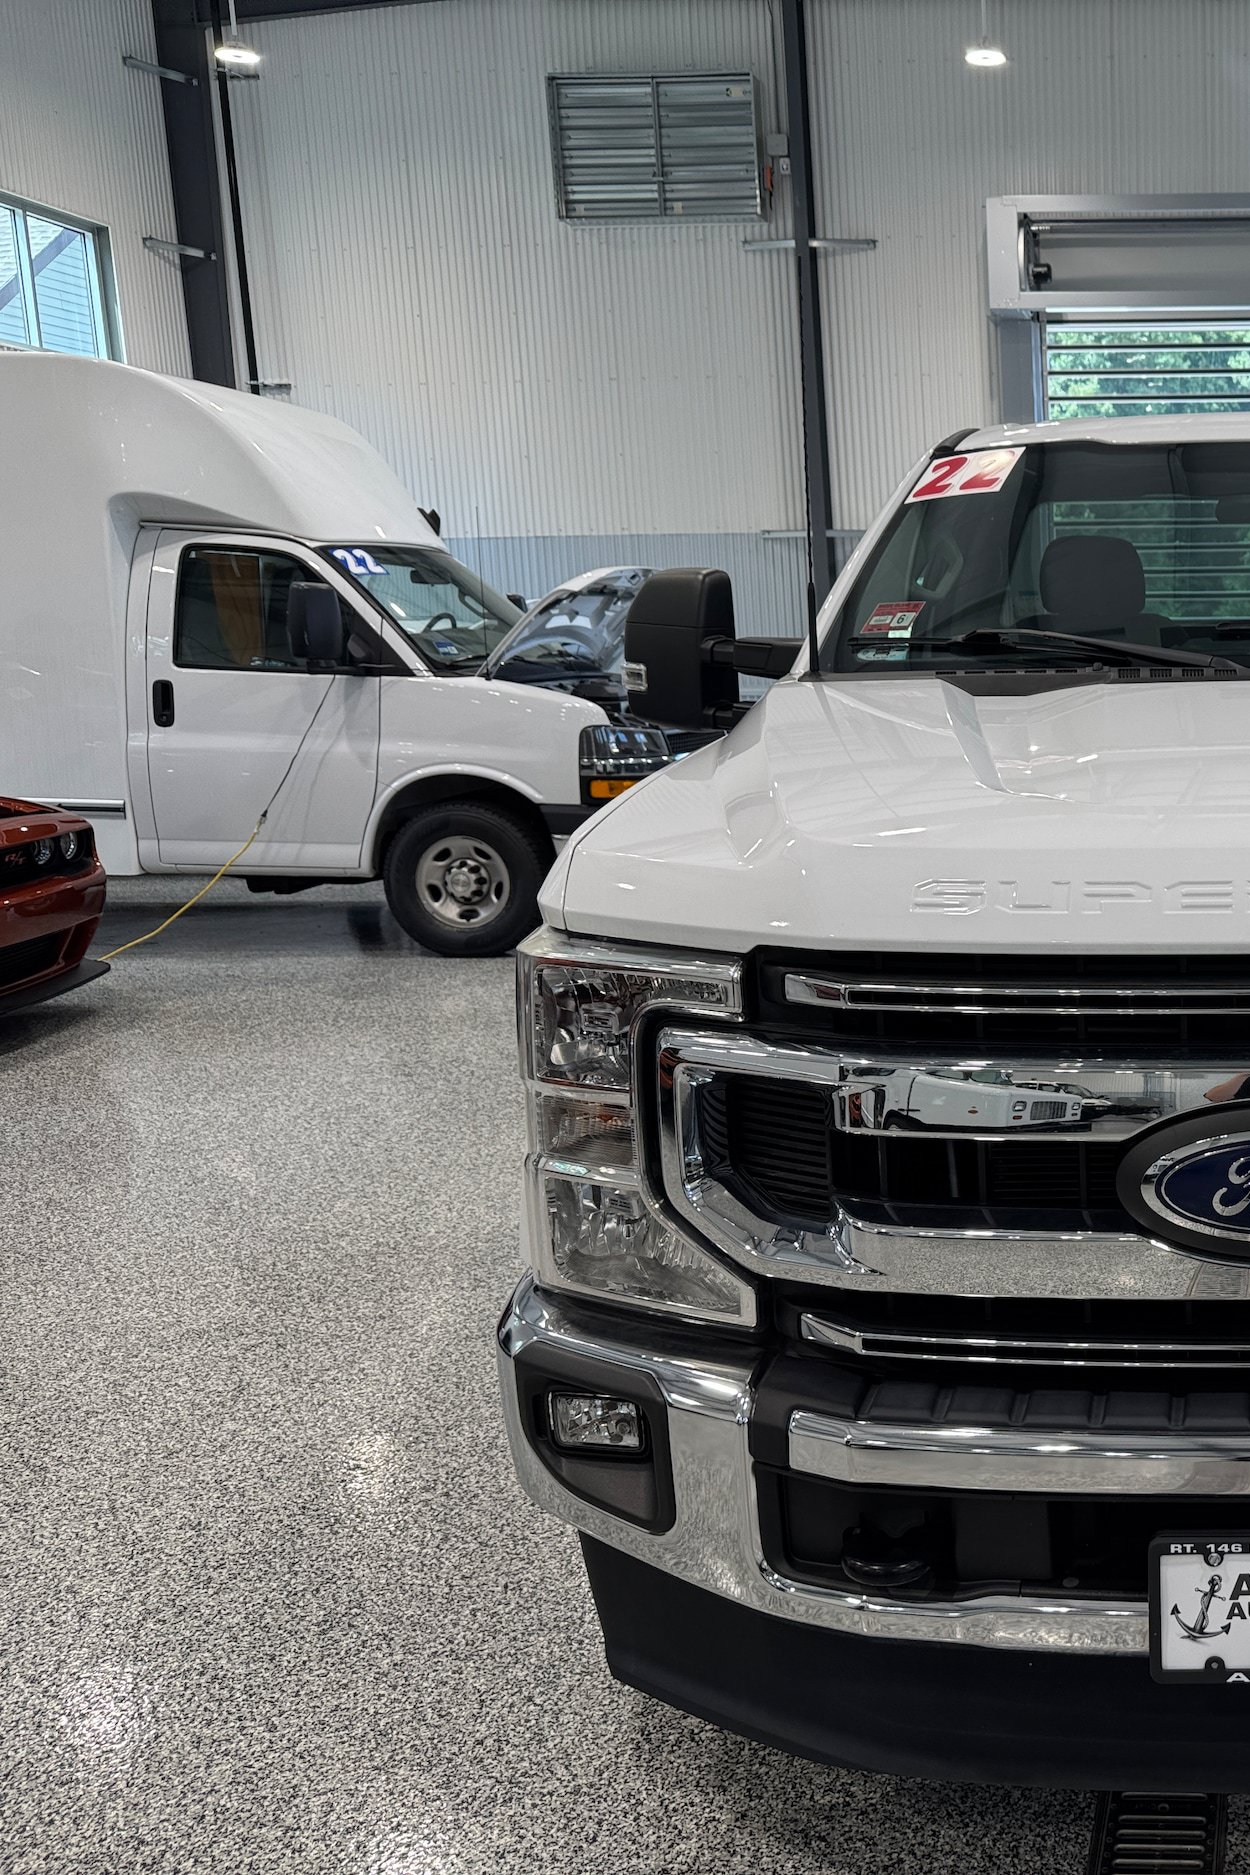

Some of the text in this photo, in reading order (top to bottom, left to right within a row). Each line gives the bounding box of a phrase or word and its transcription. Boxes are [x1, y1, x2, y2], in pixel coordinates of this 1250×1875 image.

[912, 449, 1016, 499] 22
[332, 549, 388, 575] 22
[1170, 1543, 1197, 1553] RT.
[1206, 1543, 1243, 1553] 146
